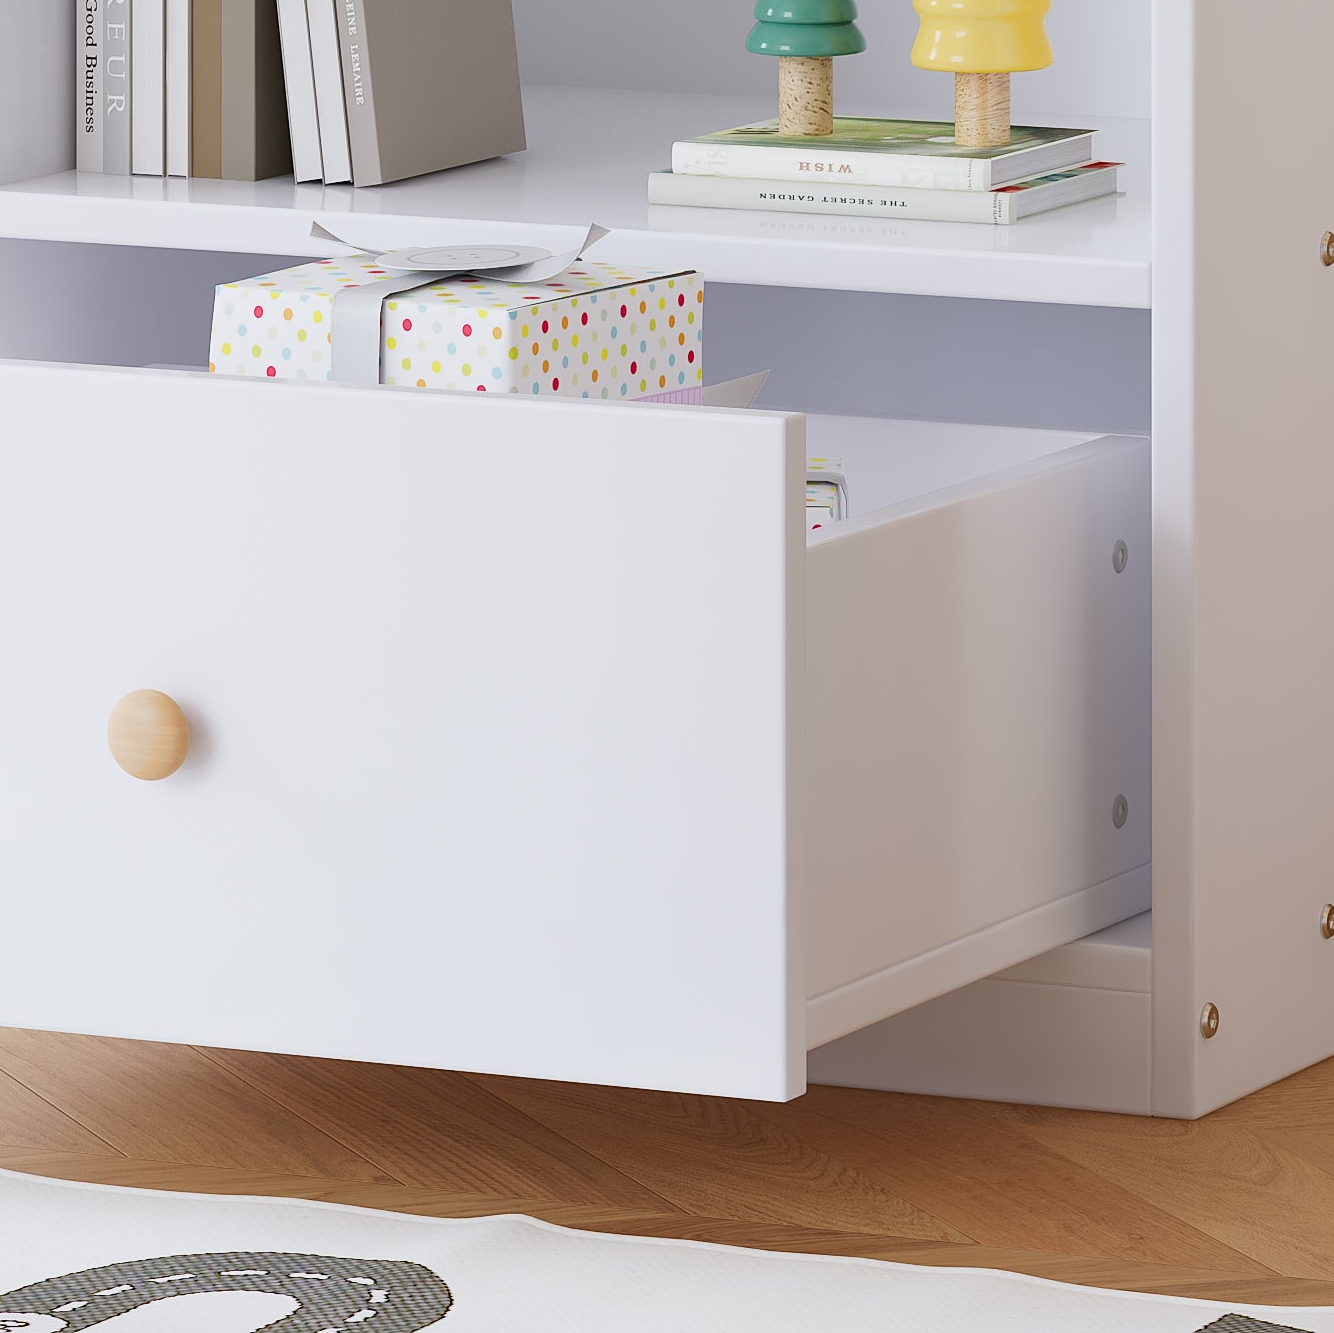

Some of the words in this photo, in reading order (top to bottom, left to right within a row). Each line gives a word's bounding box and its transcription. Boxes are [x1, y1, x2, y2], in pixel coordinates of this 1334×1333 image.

[349, 44, 364, 106] LEMAIRE
[84, 54, 99, 133] Business
[798, 161, 853, 174] WISH
[759, 193, 815, 202] GARDEN
[821, 196, 873, 206] SECRET
[880, 200, 907, 208] THE
